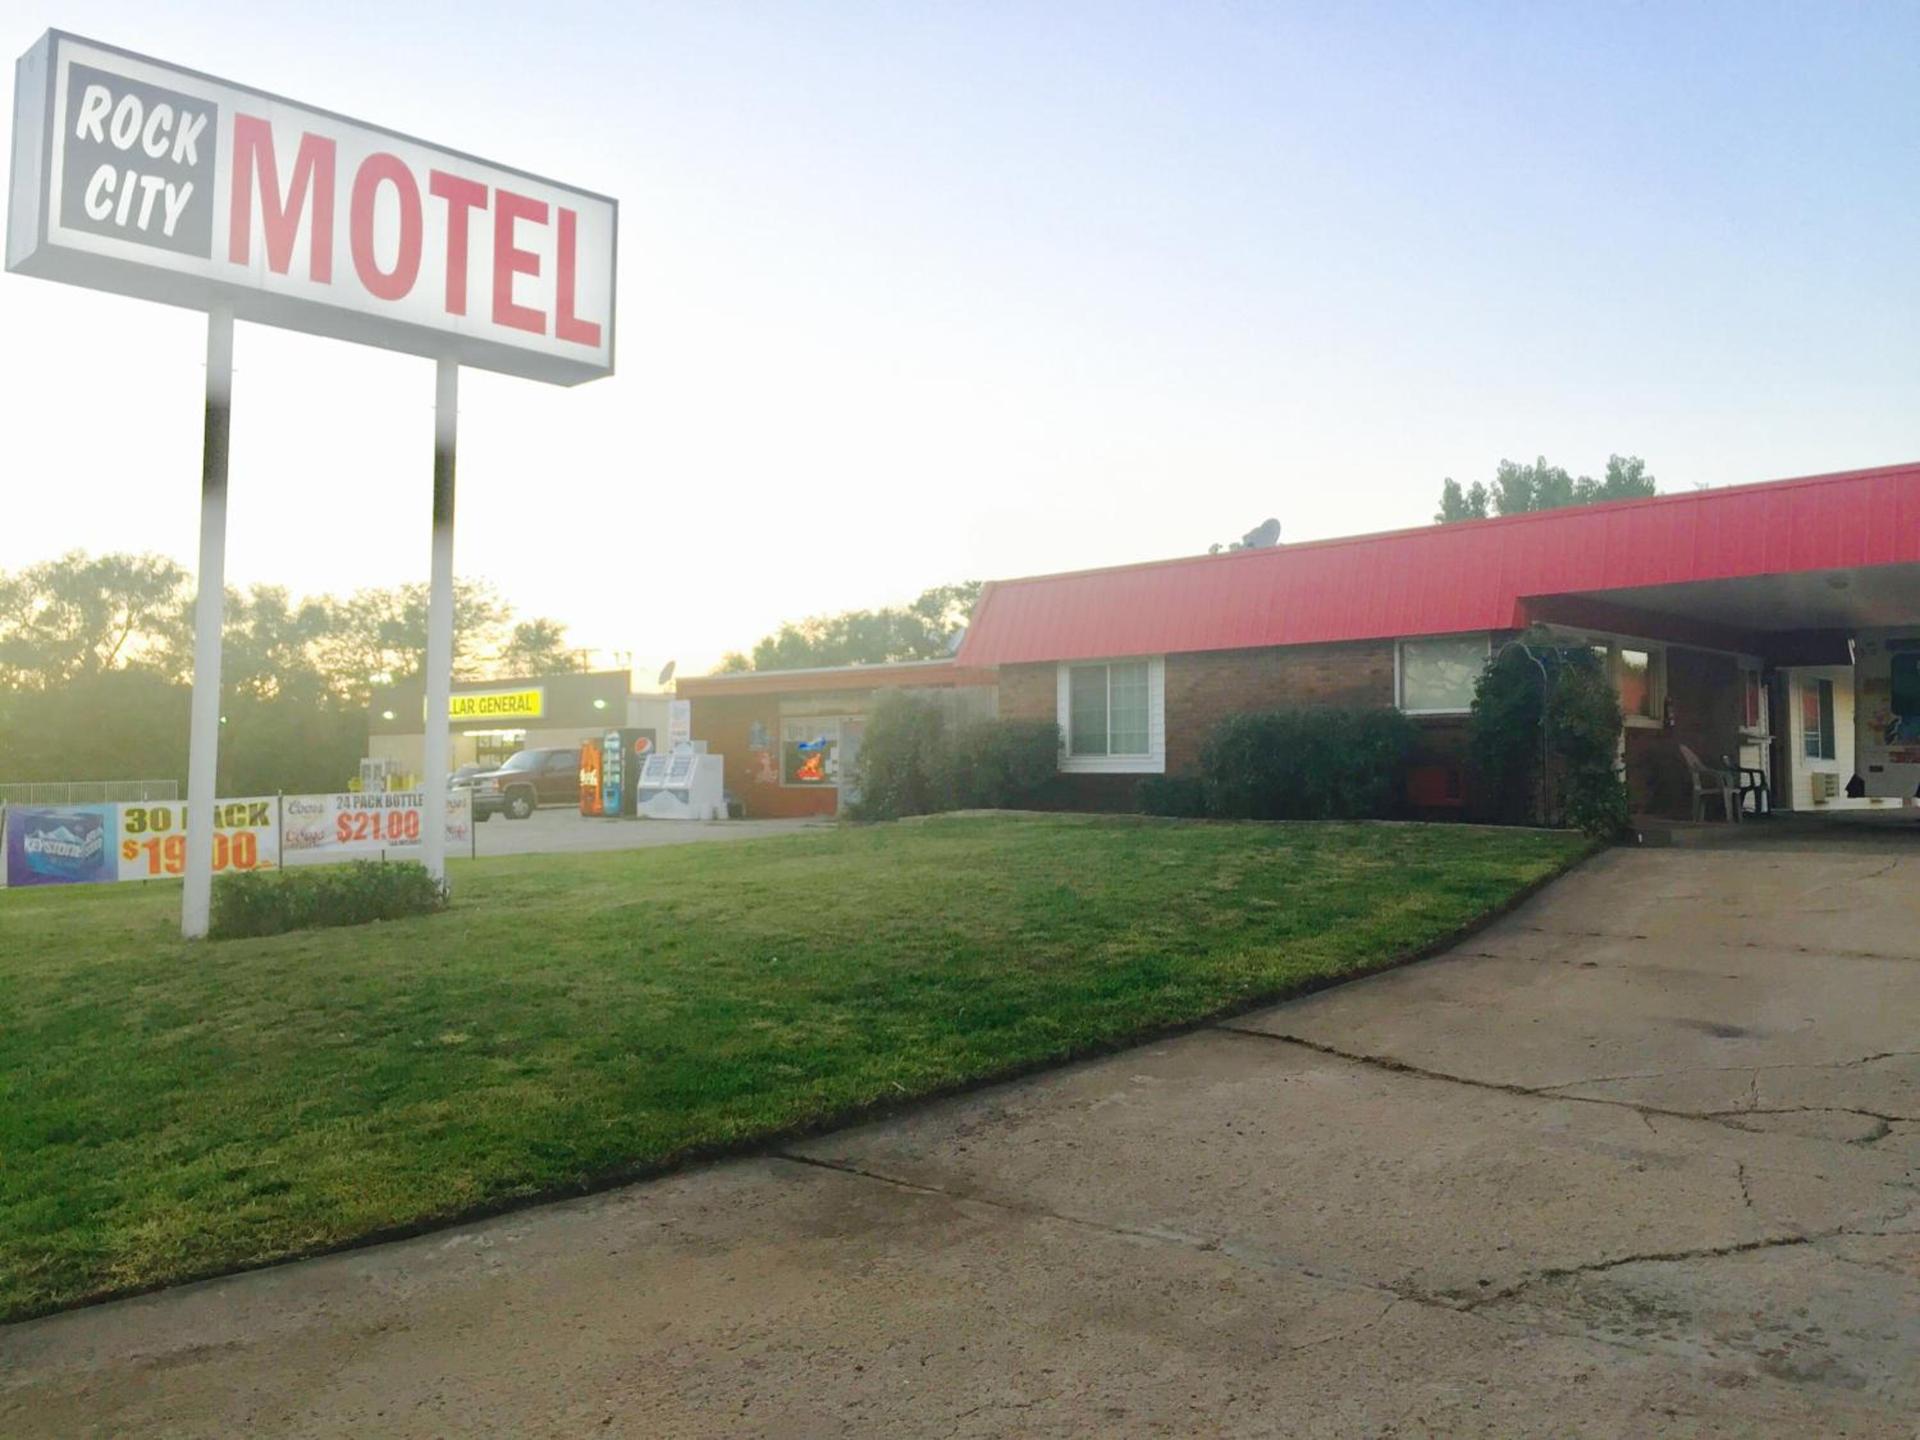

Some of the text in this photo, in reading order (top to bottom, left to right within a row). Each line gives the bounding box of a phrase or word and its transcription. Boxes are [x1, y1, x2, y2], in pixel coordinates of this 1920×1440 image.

[76, 85, 208, 167] ROCK
[84, 164, 194, 237] CITY
[228, 112, 601, 349] MOTEL
[479, 693, 532, 713] GENERAL
[125, 807, 171, 833] 30
[353, 795, 382, 809] PACK
[385, 793, 424, 808] BOTTLE
[336, 810, 419, 843] $21.00
[122, 831, 257, 875] $1900
